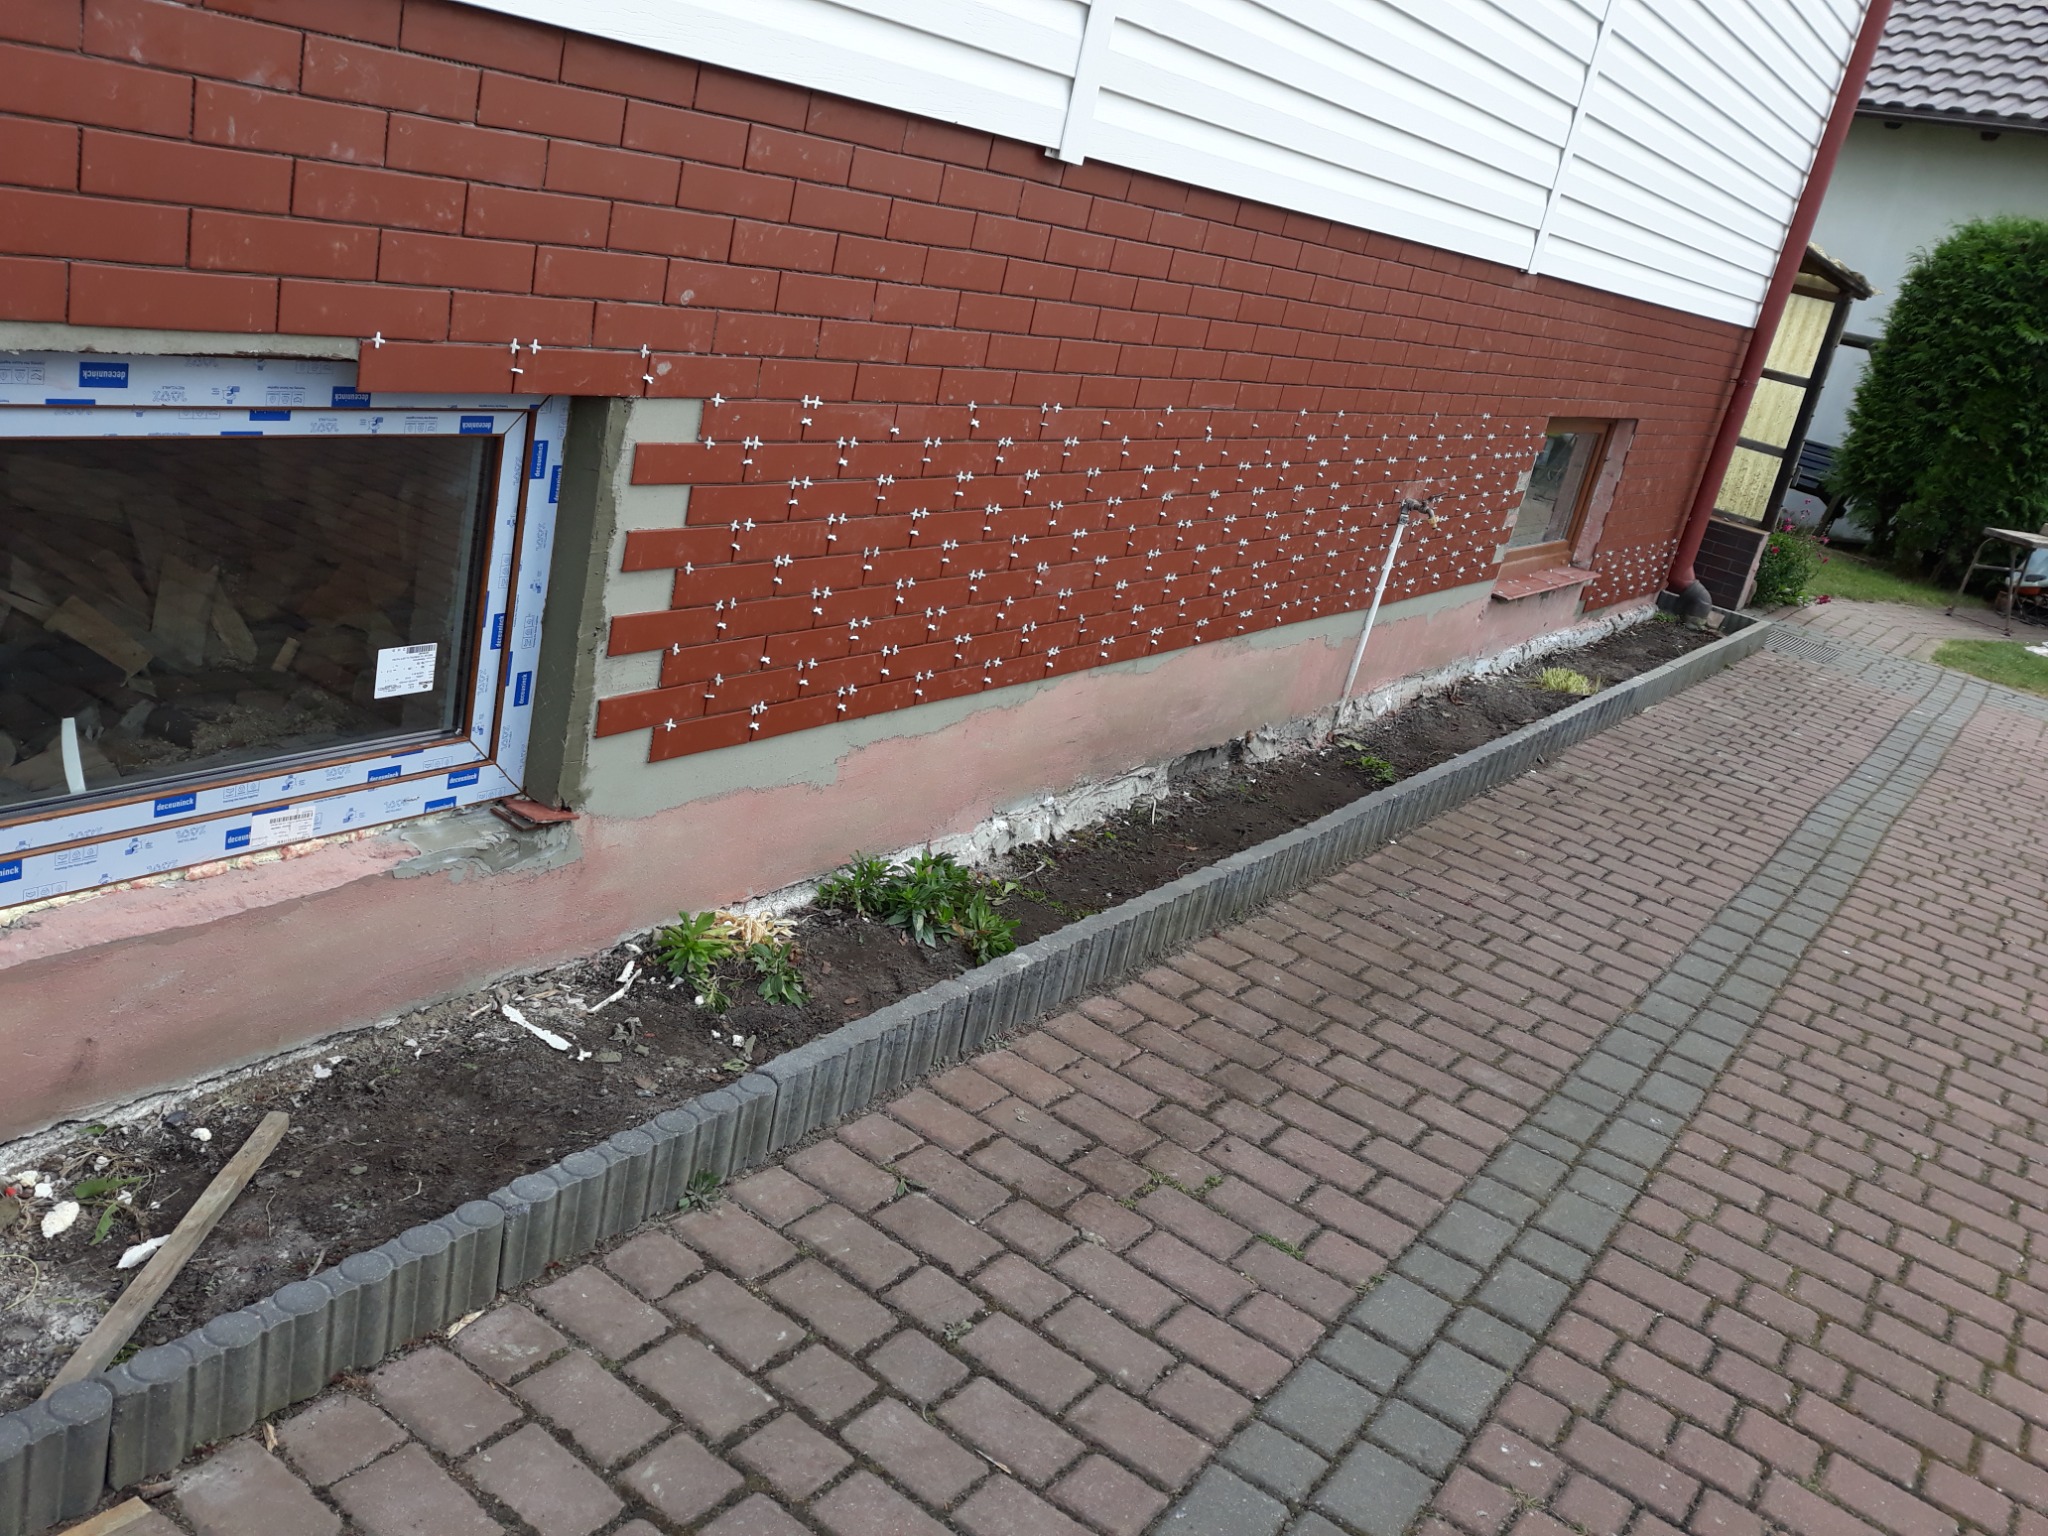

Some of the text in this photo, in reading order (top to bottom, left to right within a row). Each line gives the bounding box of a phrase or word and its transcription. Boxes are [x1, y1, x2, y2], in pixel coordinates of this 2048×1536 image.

[82, 369, 126, 380] deceuninck
[334, 393, 370, 402] deceuninck
[462, 421, 492, 430] deceuninck
[534, 442, 544, 478] deceuninck
[519, 673, 528, 705] deceuninck
[369, 771, 400, 782] deceuninck
[449, 772, 477, 784] deceuninck
[156, 797, 194, 811] deceuninck
